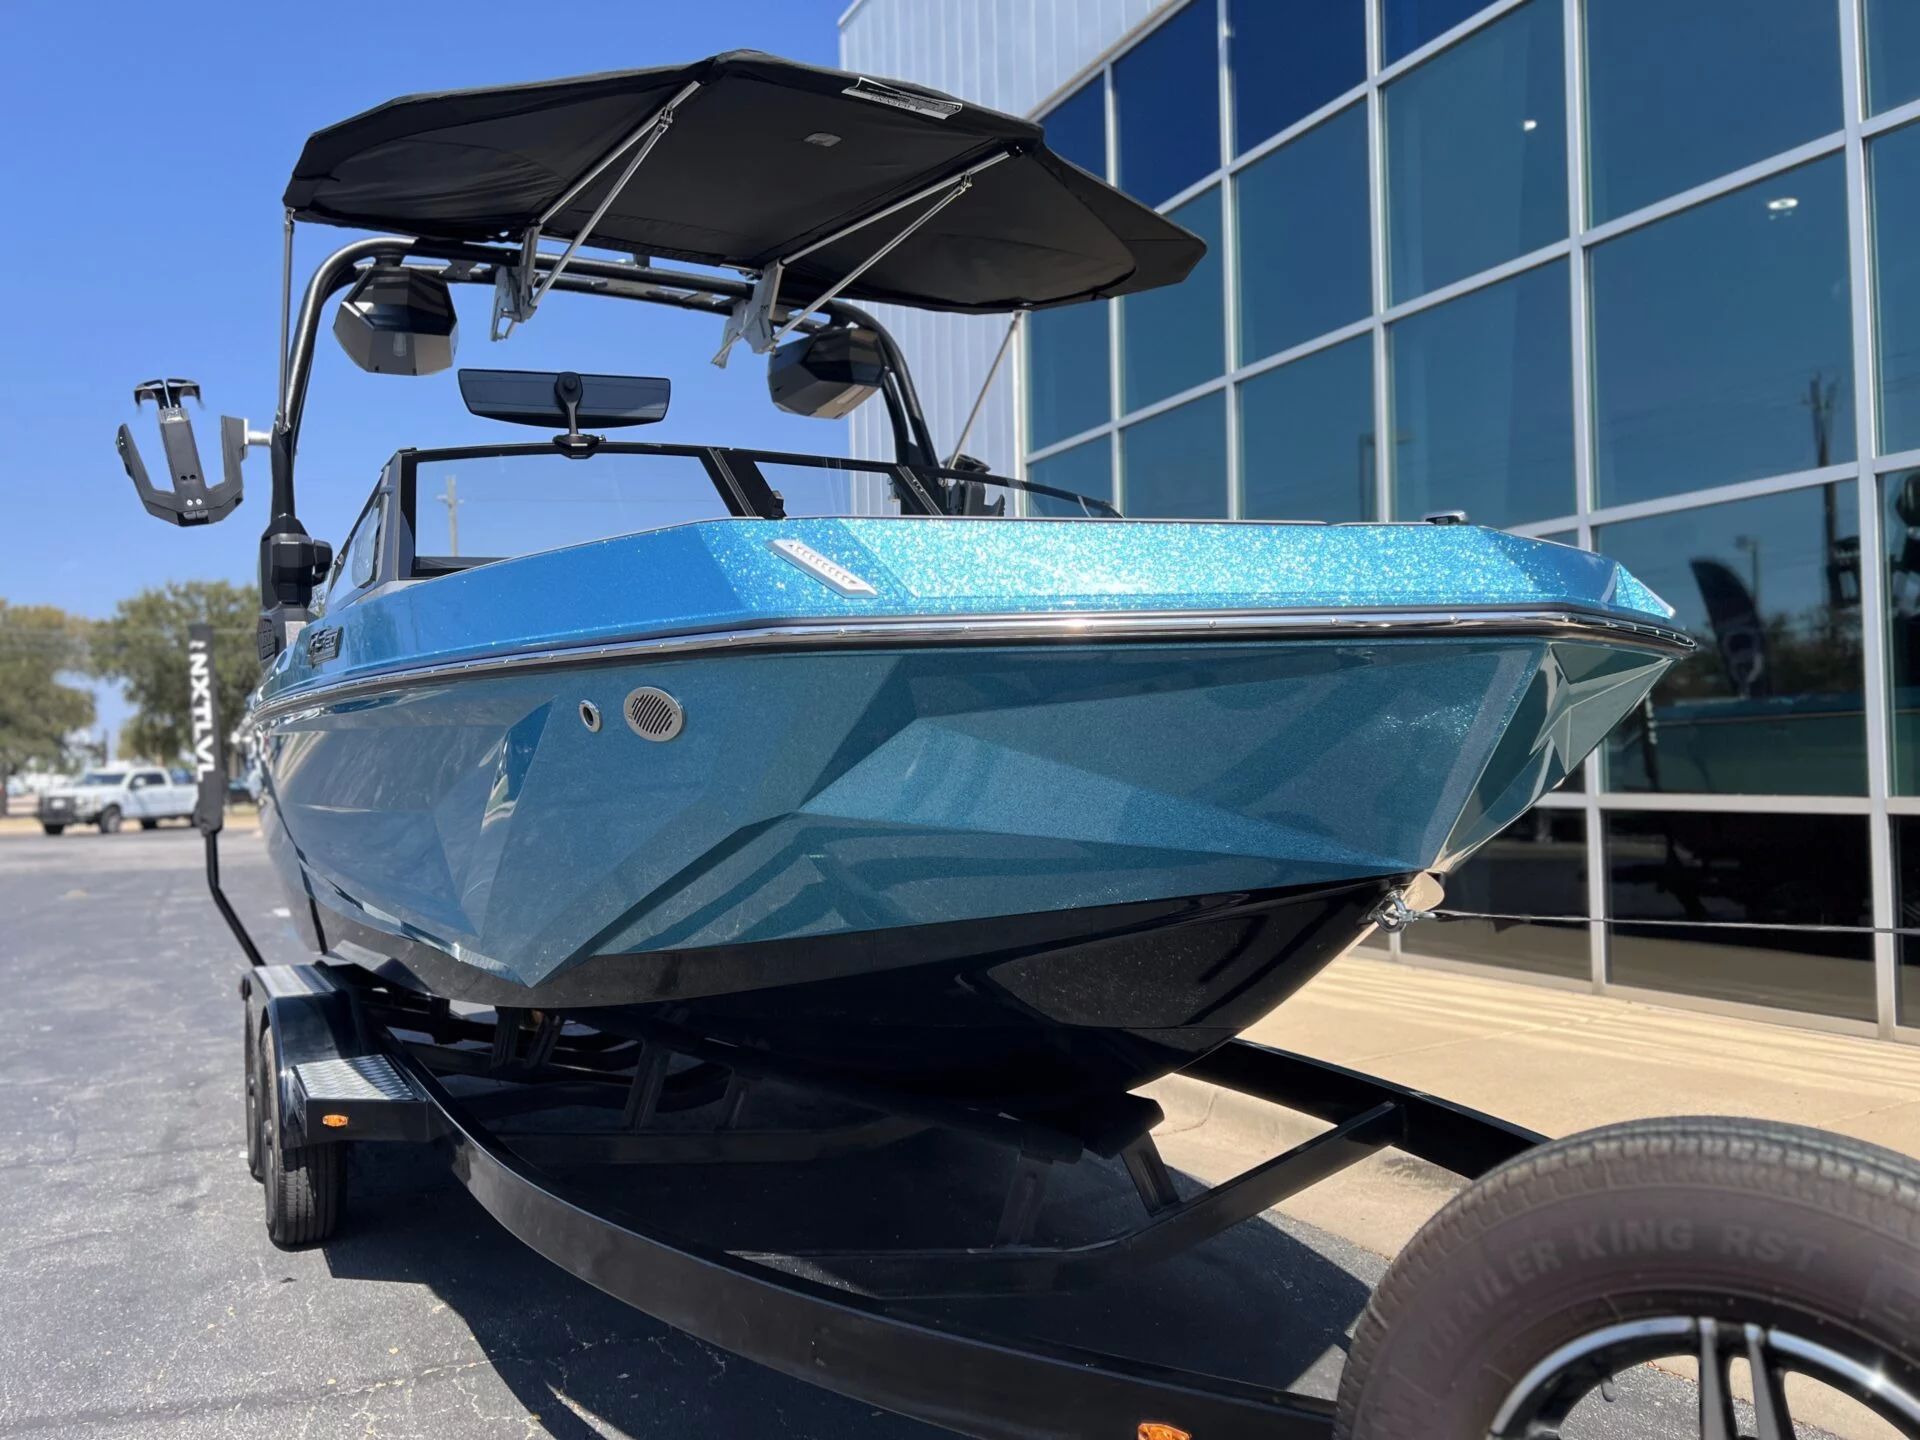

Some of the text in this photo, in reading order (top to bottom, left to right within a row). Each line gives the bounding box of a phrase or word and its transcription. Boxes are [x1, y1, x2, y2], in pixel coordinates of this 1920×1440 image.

[189, 652, 215, 783] NXTLVL
[1573, 1217, 1694, 1260] KING
[1721, 1223, 1827, 1271] RST
